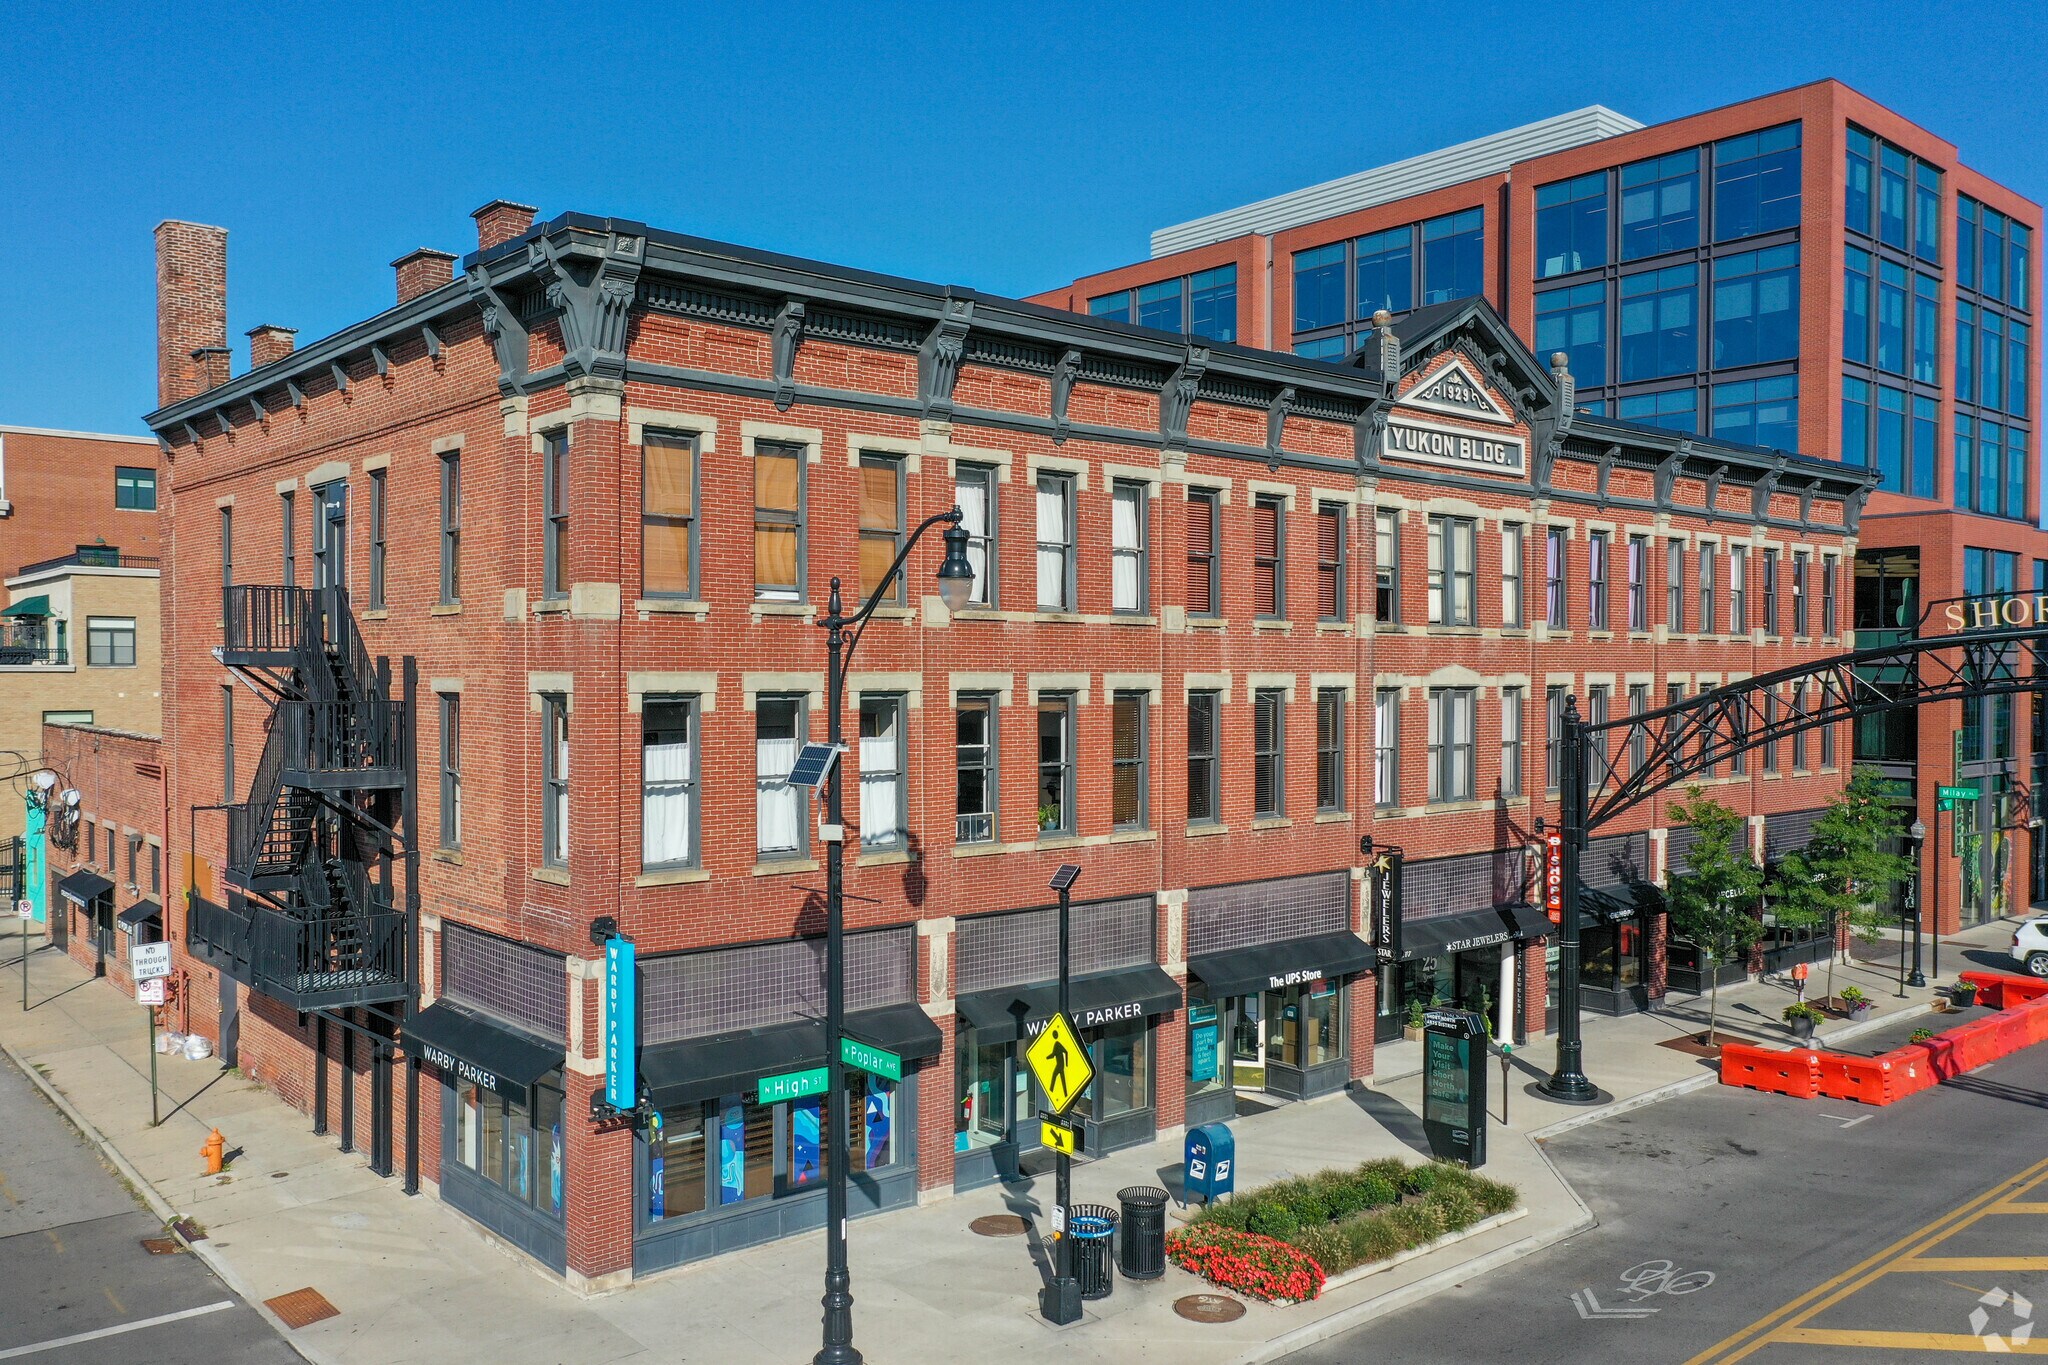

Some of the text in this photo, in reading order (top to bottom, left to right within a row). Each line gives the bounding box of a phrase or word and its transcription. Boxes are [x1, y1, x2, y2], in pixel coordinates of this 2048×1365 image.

[1442, 384, 1469, 402] 1929
[1390, 426, 1511, 465] YUKON BLDG.
[1548, 836, 1560, 904] BISHOPS
[1382, 872, 1391, 943] JEWELERS
[1452, 938, 1472, 950] STAR
[1378, 948, 1392, 958] STAR
[135, 956, 167, 966] THROUGH
[140, 966, 164, 975] TRUCKS
[610, 948, 618, 1013] WARBY
[1269, 970, 1322, 988] The UPS Store
[1086, 1003, 1142, 1025] PARKER
[1433, 1041, 1454, 1052] Make
[851, 1046, 883, 1070] Poplar
[886, 1062, 896, 1071] AVE
[1433, 1050, 1450, 1060] Your
[423, 1044, 496, 1090] WARBY PARKER
[1433, 1060, 1450, 1070] Visit
[1433, 1070, 1453, 1080] Short
[774, 1077, 809, 1096] High
[814, 1076, 822, 1085] ST
[1433, 1079, 1454, 1090] North
[1432, 1089, 1449, 1099] Safe
